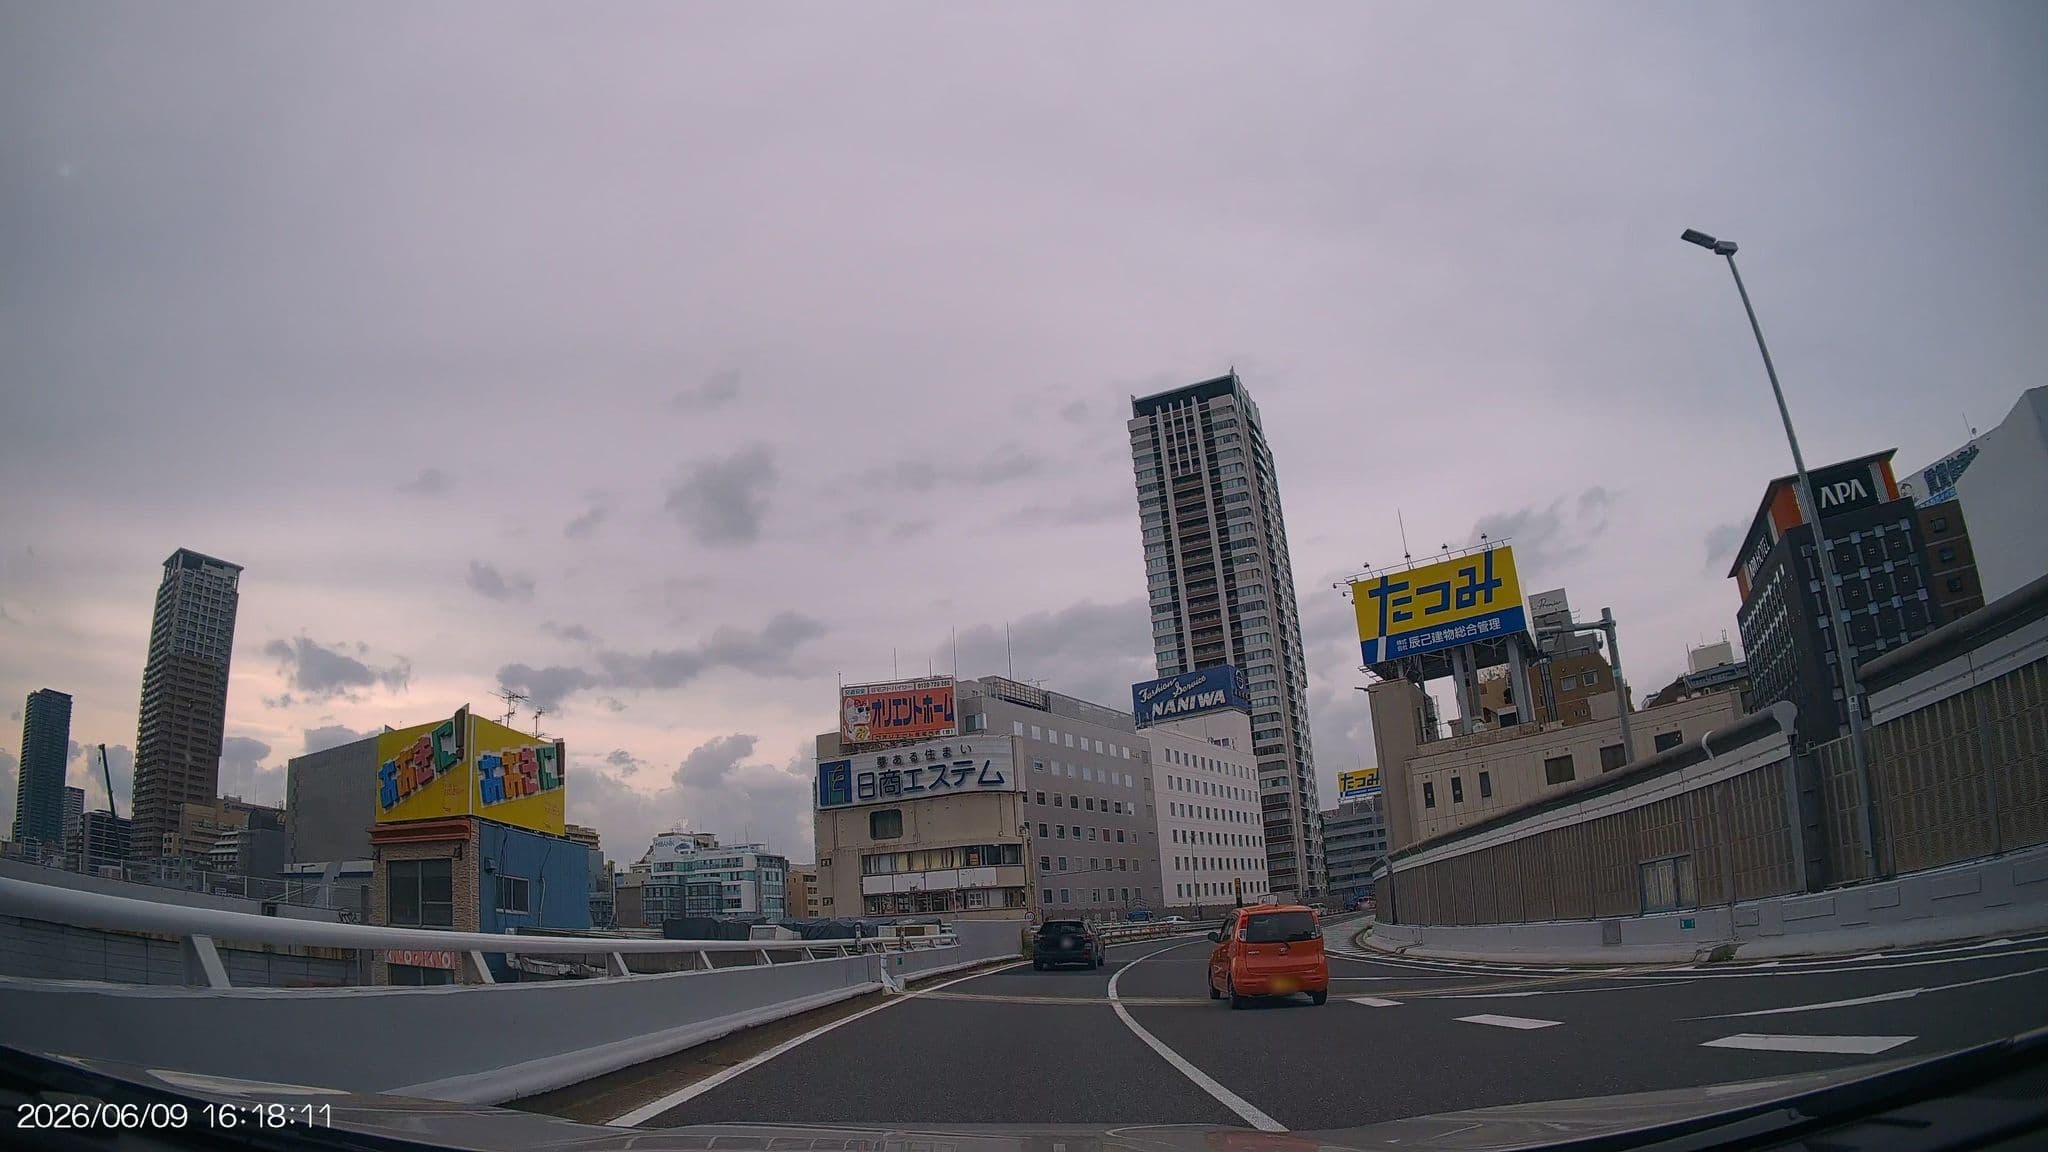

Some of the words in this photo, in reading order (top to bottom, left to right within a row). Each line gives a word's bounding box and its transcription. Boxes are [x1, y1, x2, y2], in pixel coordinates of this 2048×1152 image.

[1820, 478, 1868, 509] APA
[1368, 550, 1502, 638] たつみ
[1138, 678, 1178, 703] Fashion
[1172, 674, 1207, 698] Service
[1152, 689, 1226, 716] NANIWA
[872, 693, 955, 729] オリエントホーム
[876, 743, 973, 769] 夢ある住まい
[857, 759, 1006, 800] 日商エステム
